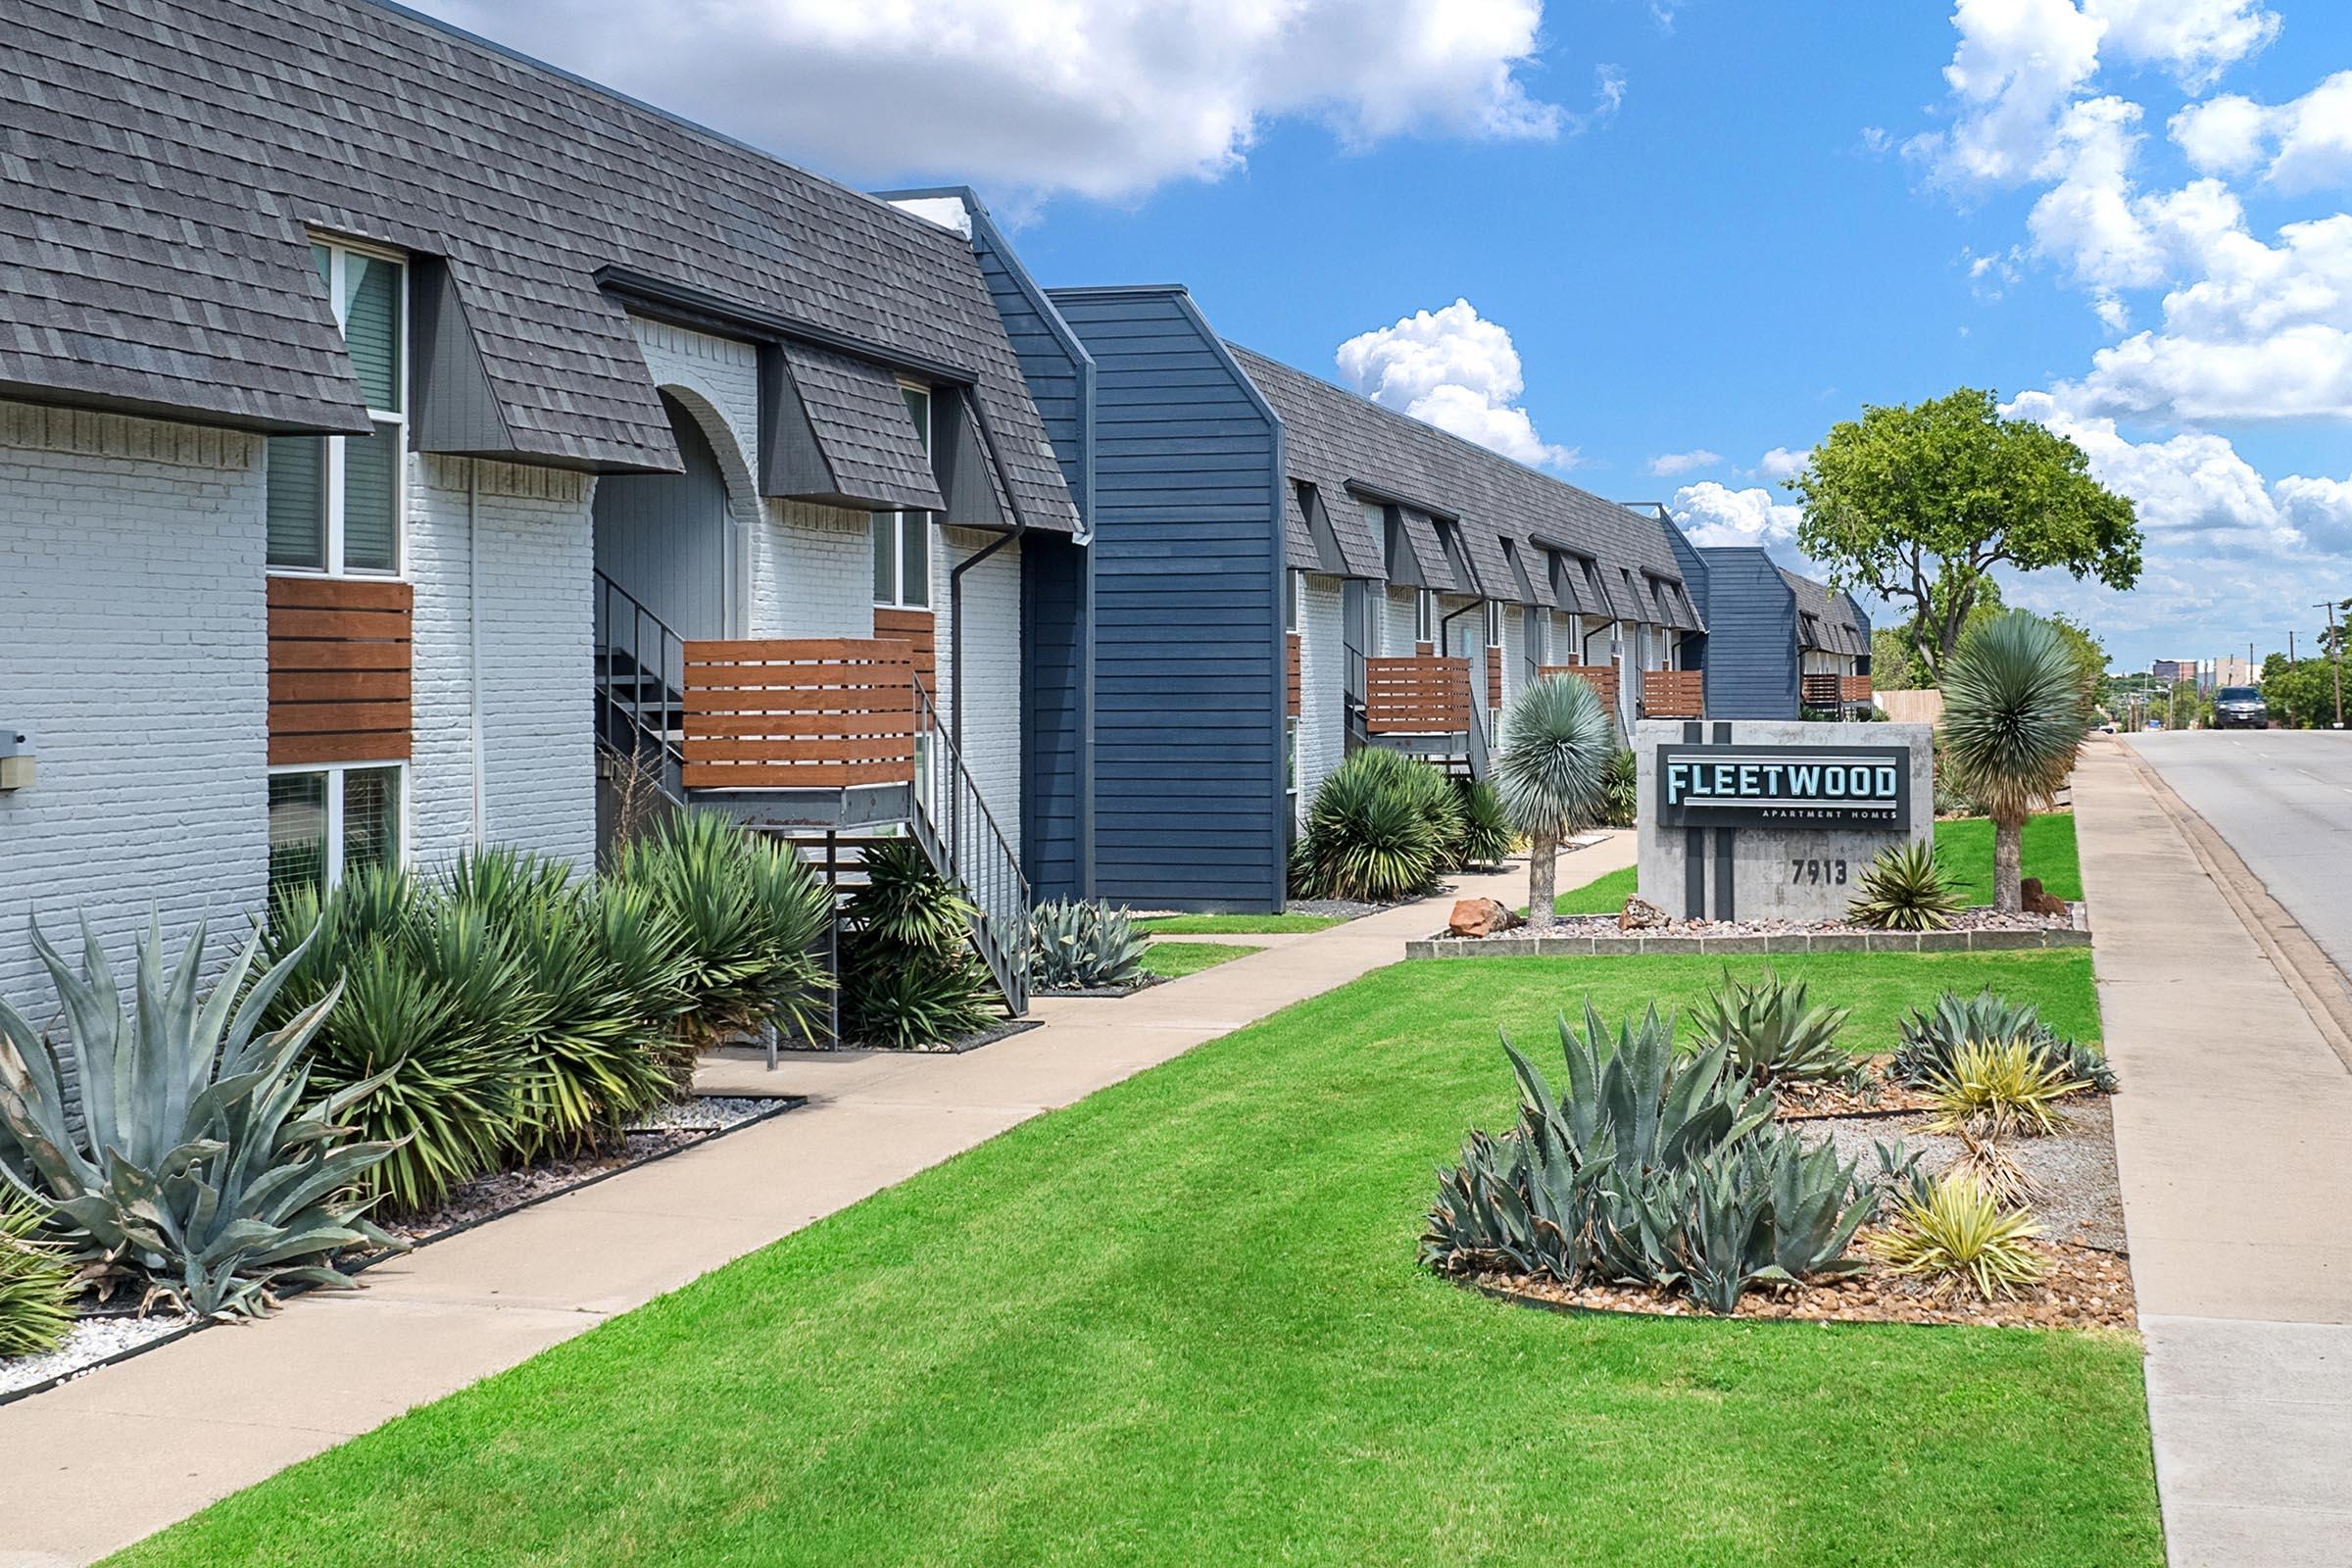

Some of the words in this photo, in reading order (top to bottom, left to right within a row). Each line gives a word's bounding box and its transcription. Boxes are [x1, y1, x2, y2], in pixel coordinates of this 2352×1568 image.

[1668, 764, 1896, 805] FLEETWOOD
[1762, 809, 1842, 818] APARTMENT
[1791, 859, 1847, 885] 7913
